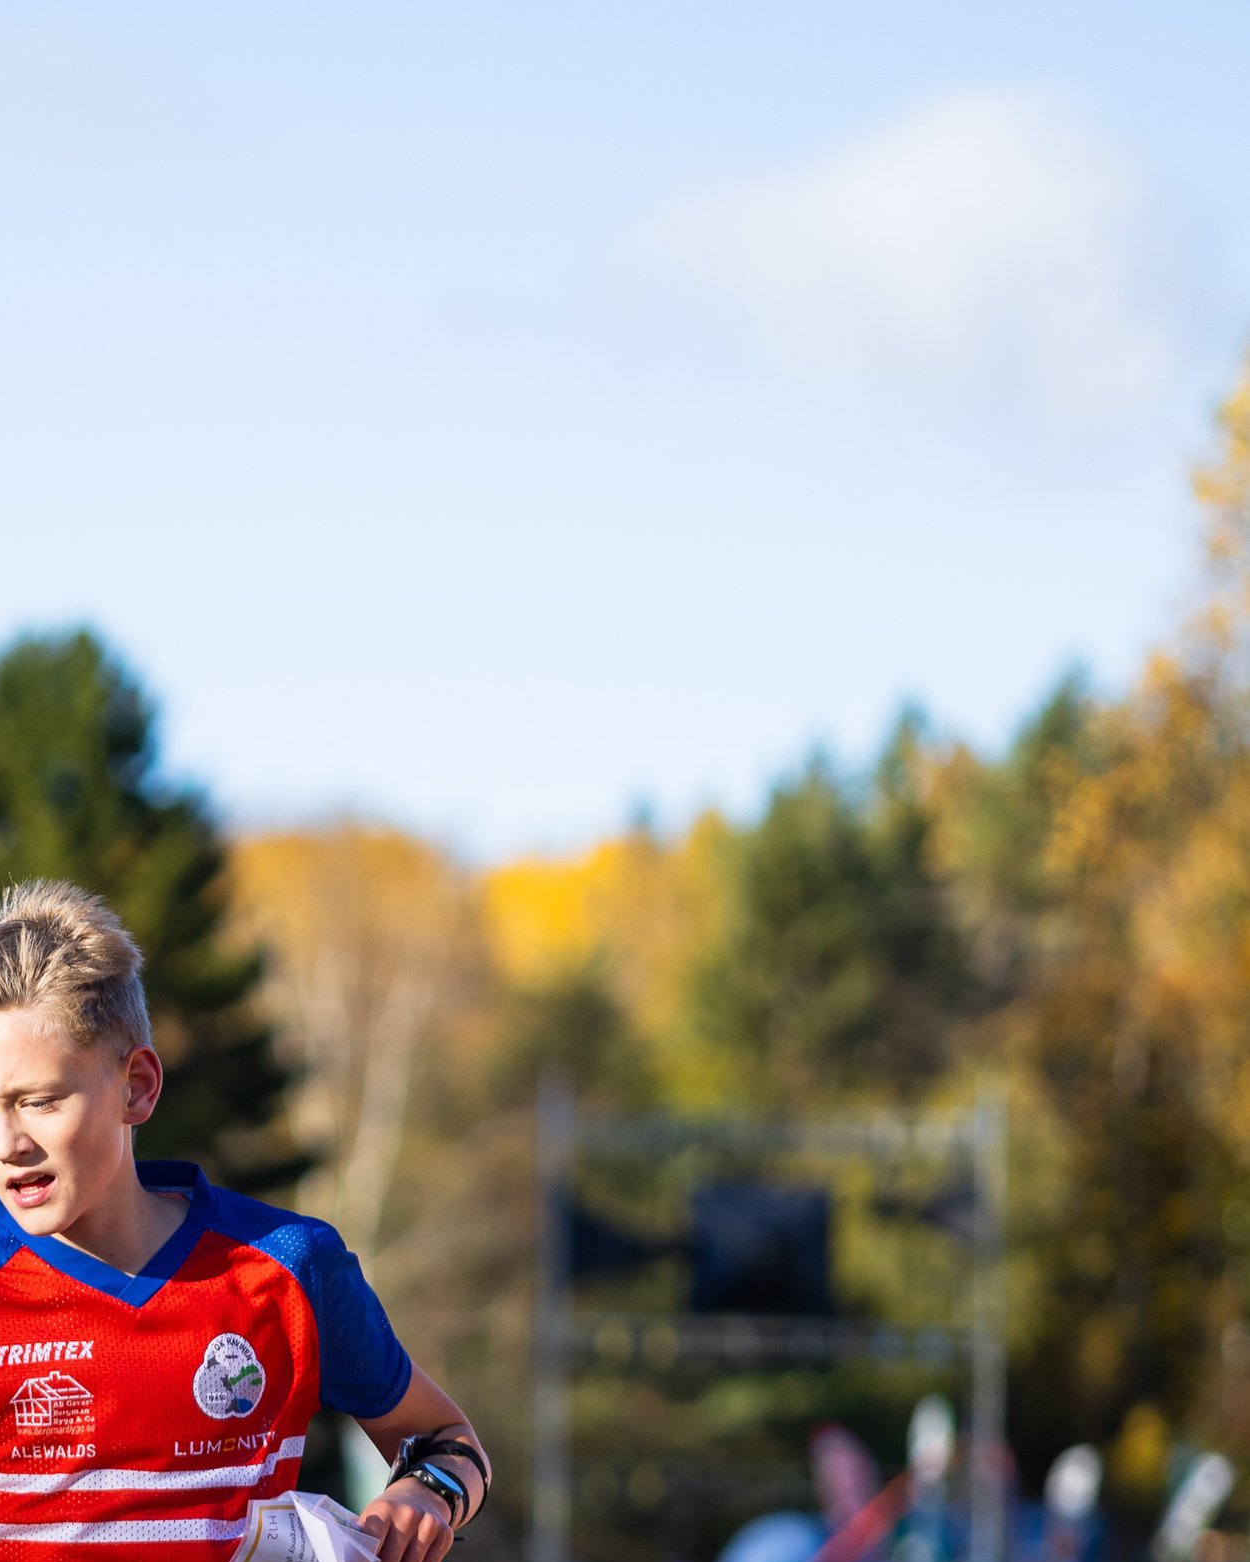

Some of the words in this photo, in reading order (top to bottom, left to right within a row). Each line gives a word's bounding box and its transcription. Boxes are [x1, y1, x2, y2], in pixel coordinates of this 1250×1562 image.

[214, 1340, 226, 1352] OK
[226, 1337, 254, 1361] RAVINEN
[12, 1444, 96, 1459] ALEWALDS
[174, 1431, 275, 1456] LUMONIT
[267, 1514, 279, 1540] H12
[288, 1512, 297, 1553] Emergency
